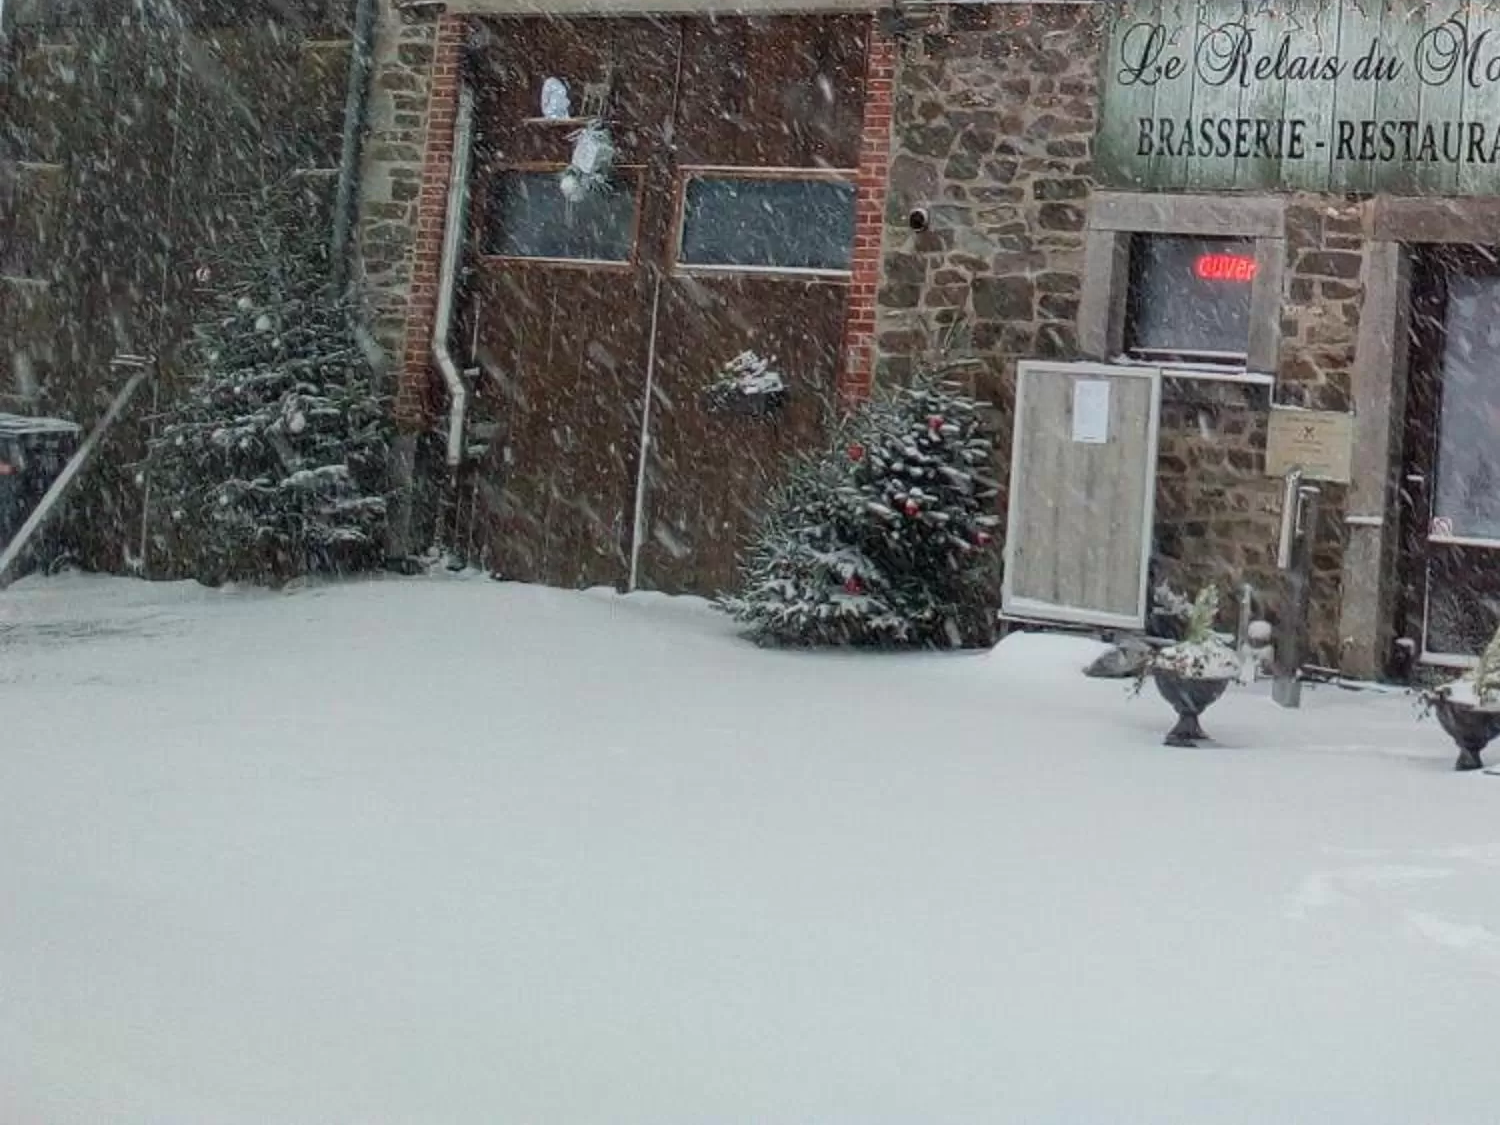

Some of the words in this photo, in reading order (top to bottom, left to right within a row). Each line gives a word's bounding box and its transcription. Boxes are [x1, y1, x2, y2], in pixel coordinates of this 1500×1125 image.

[1117, 22, 1187, 87] Le
[1195, 22, 1348, 89] Relais
[1352, 36, 1405, 82] du
[1136, 117, 1306, 159] BRASSERIE
